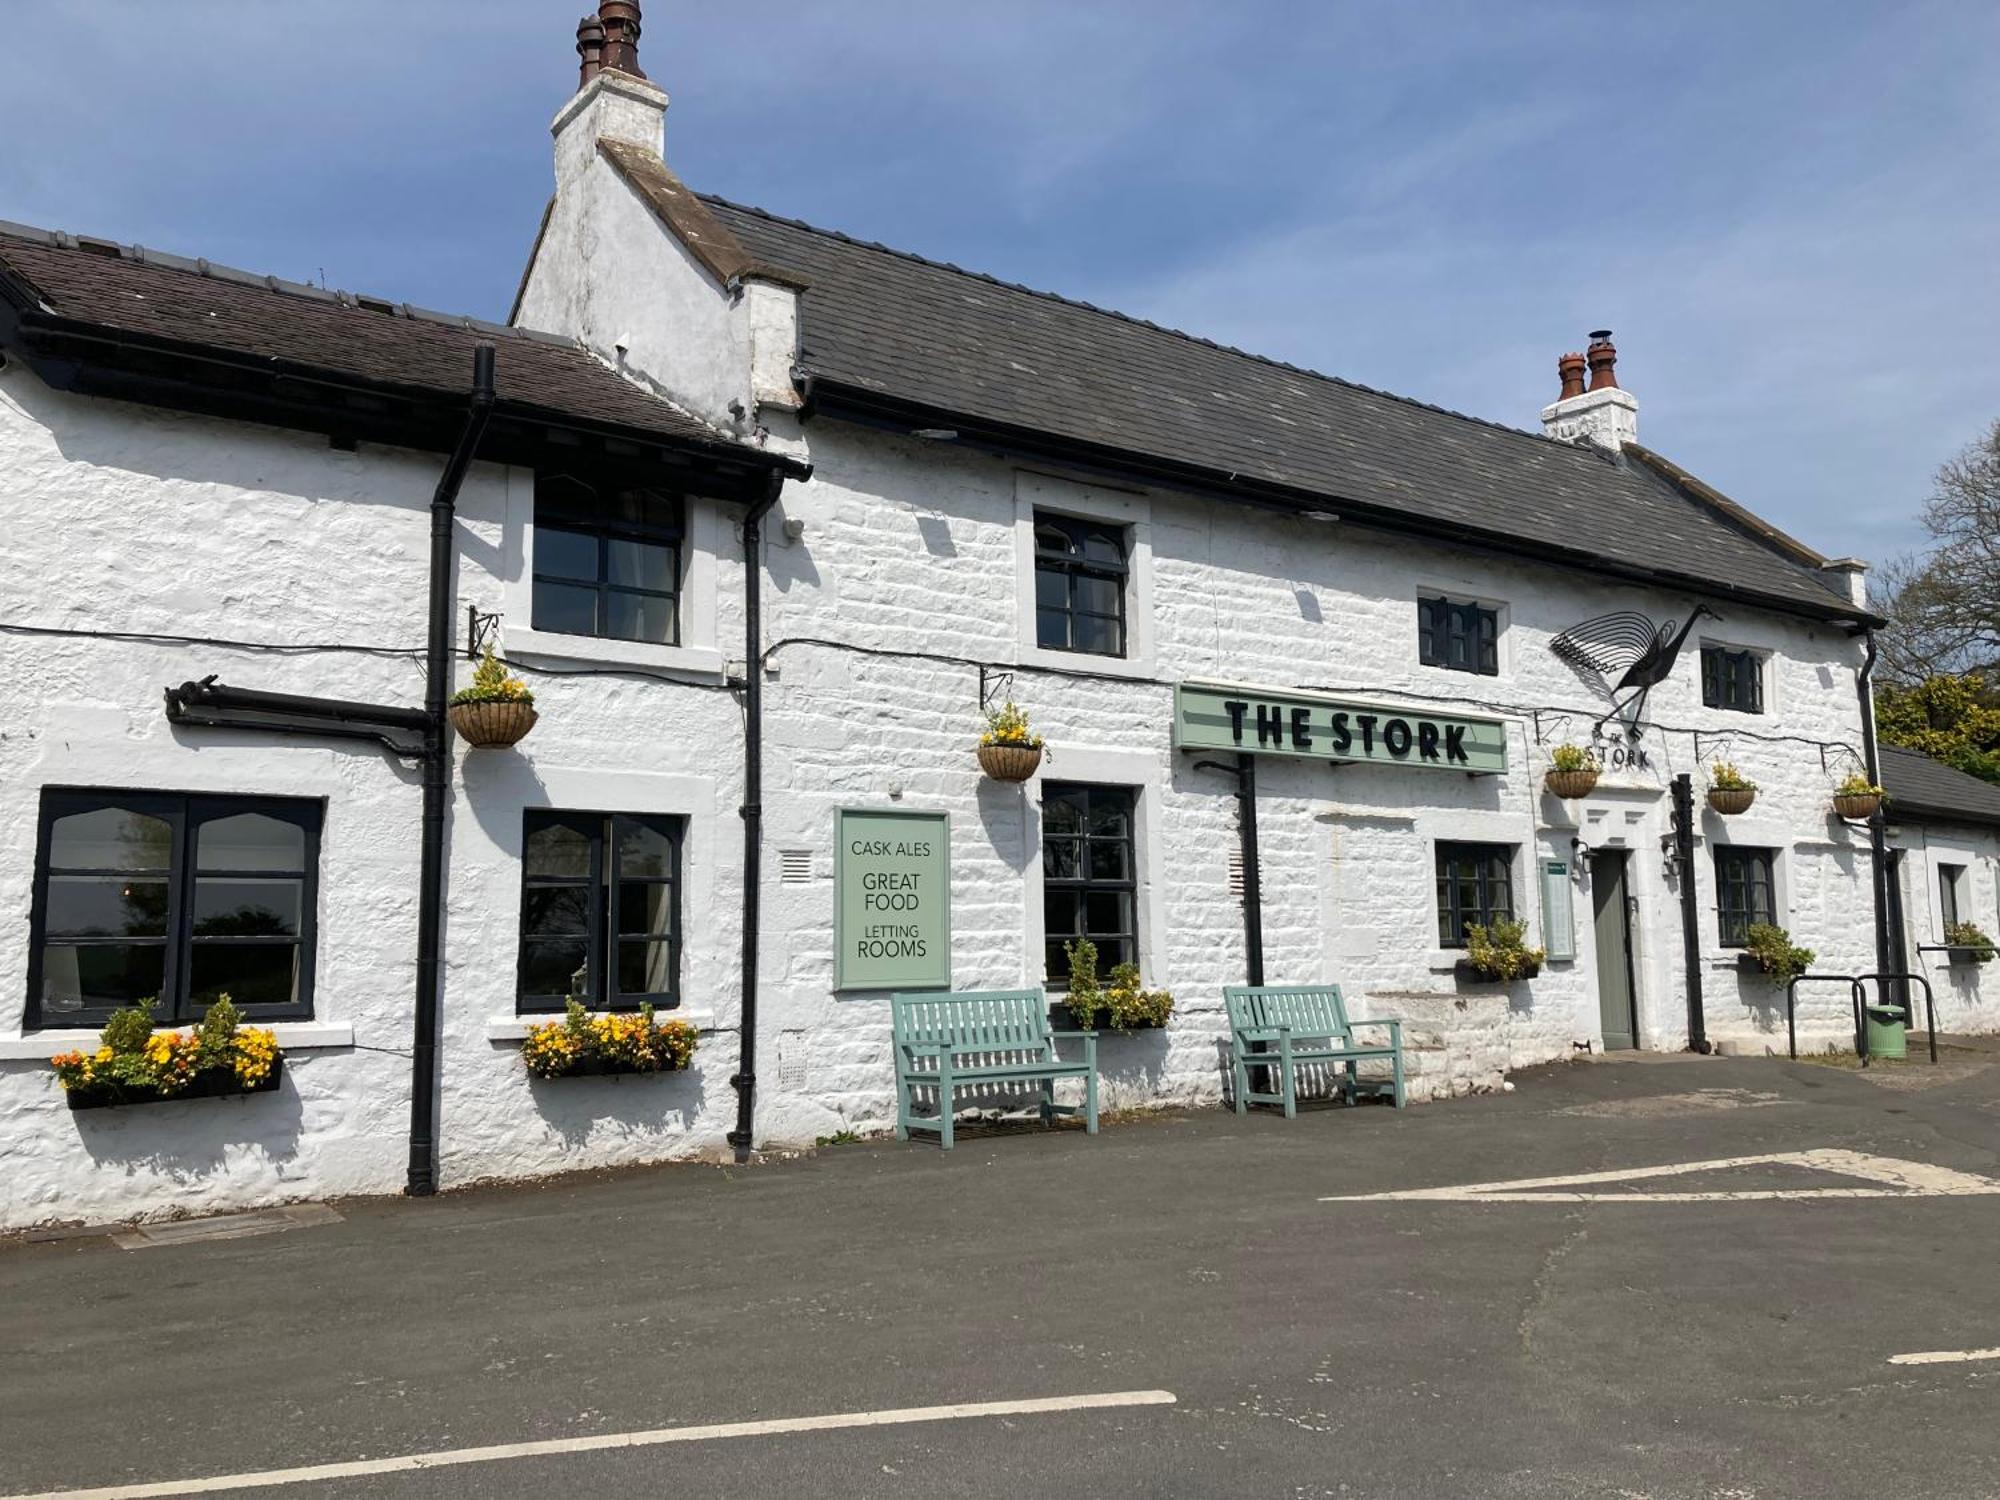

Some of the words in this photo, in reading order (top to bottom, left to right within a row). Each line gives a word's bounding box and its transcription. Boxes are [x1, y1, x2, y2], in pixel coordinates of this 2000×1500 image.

[1224, 701, 1313, 747] THE
[1331, 712, 1470, 761] STORK
[1585, 745, 1650, 767] STORK
[851, 840, 892, 856] CASK
[895, 841, 931, 857] ALES
[863, 872, 921, 890] GREAT
[865, 893, 919, 911] FOOD
[865, 924, 919, 938] LETTING
[858, 939, 927, 959] ROOMS
